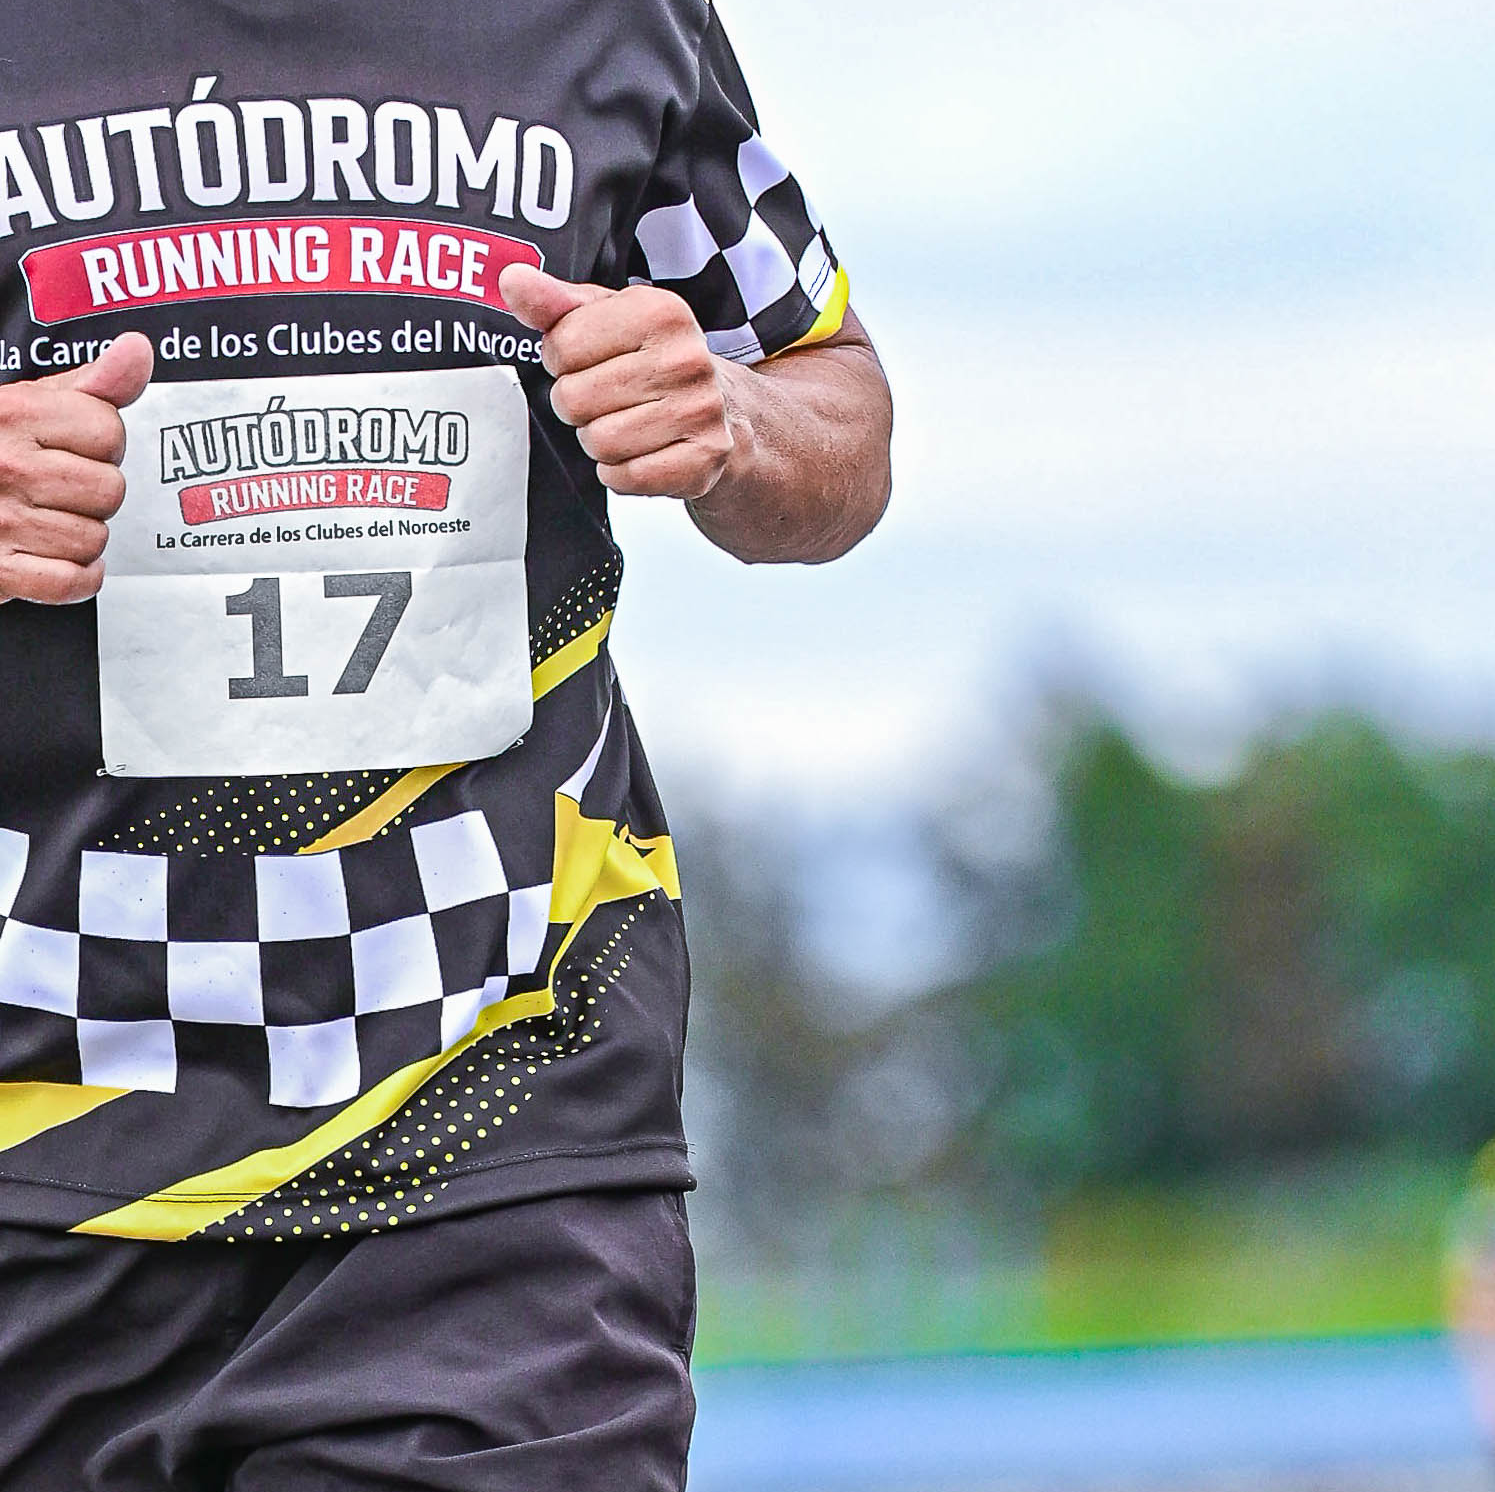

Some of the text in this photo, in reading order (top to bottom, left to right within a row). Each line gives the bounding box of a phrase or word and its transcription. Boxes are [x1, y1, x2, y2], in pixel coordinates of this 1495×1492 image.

[80, 224, 490, 308] RUNNING RACE
[30, 336, 114, 367] Carr
[160, 327, 201, 360] de
[210, 325, 258, 358] los
[266, 322, 382, 356] Clubes
[390, 320, 442, 353] del
[453, 321, 543, 364] Noroes
[160, 395, 469, 485] AUTÓDROMO
[210, 473, 420, 518] RUNNING RACE
[156, 518, 471, 549] La Carrera de los Clubes del Noroeste
[225, 571, 413, 700] 17
